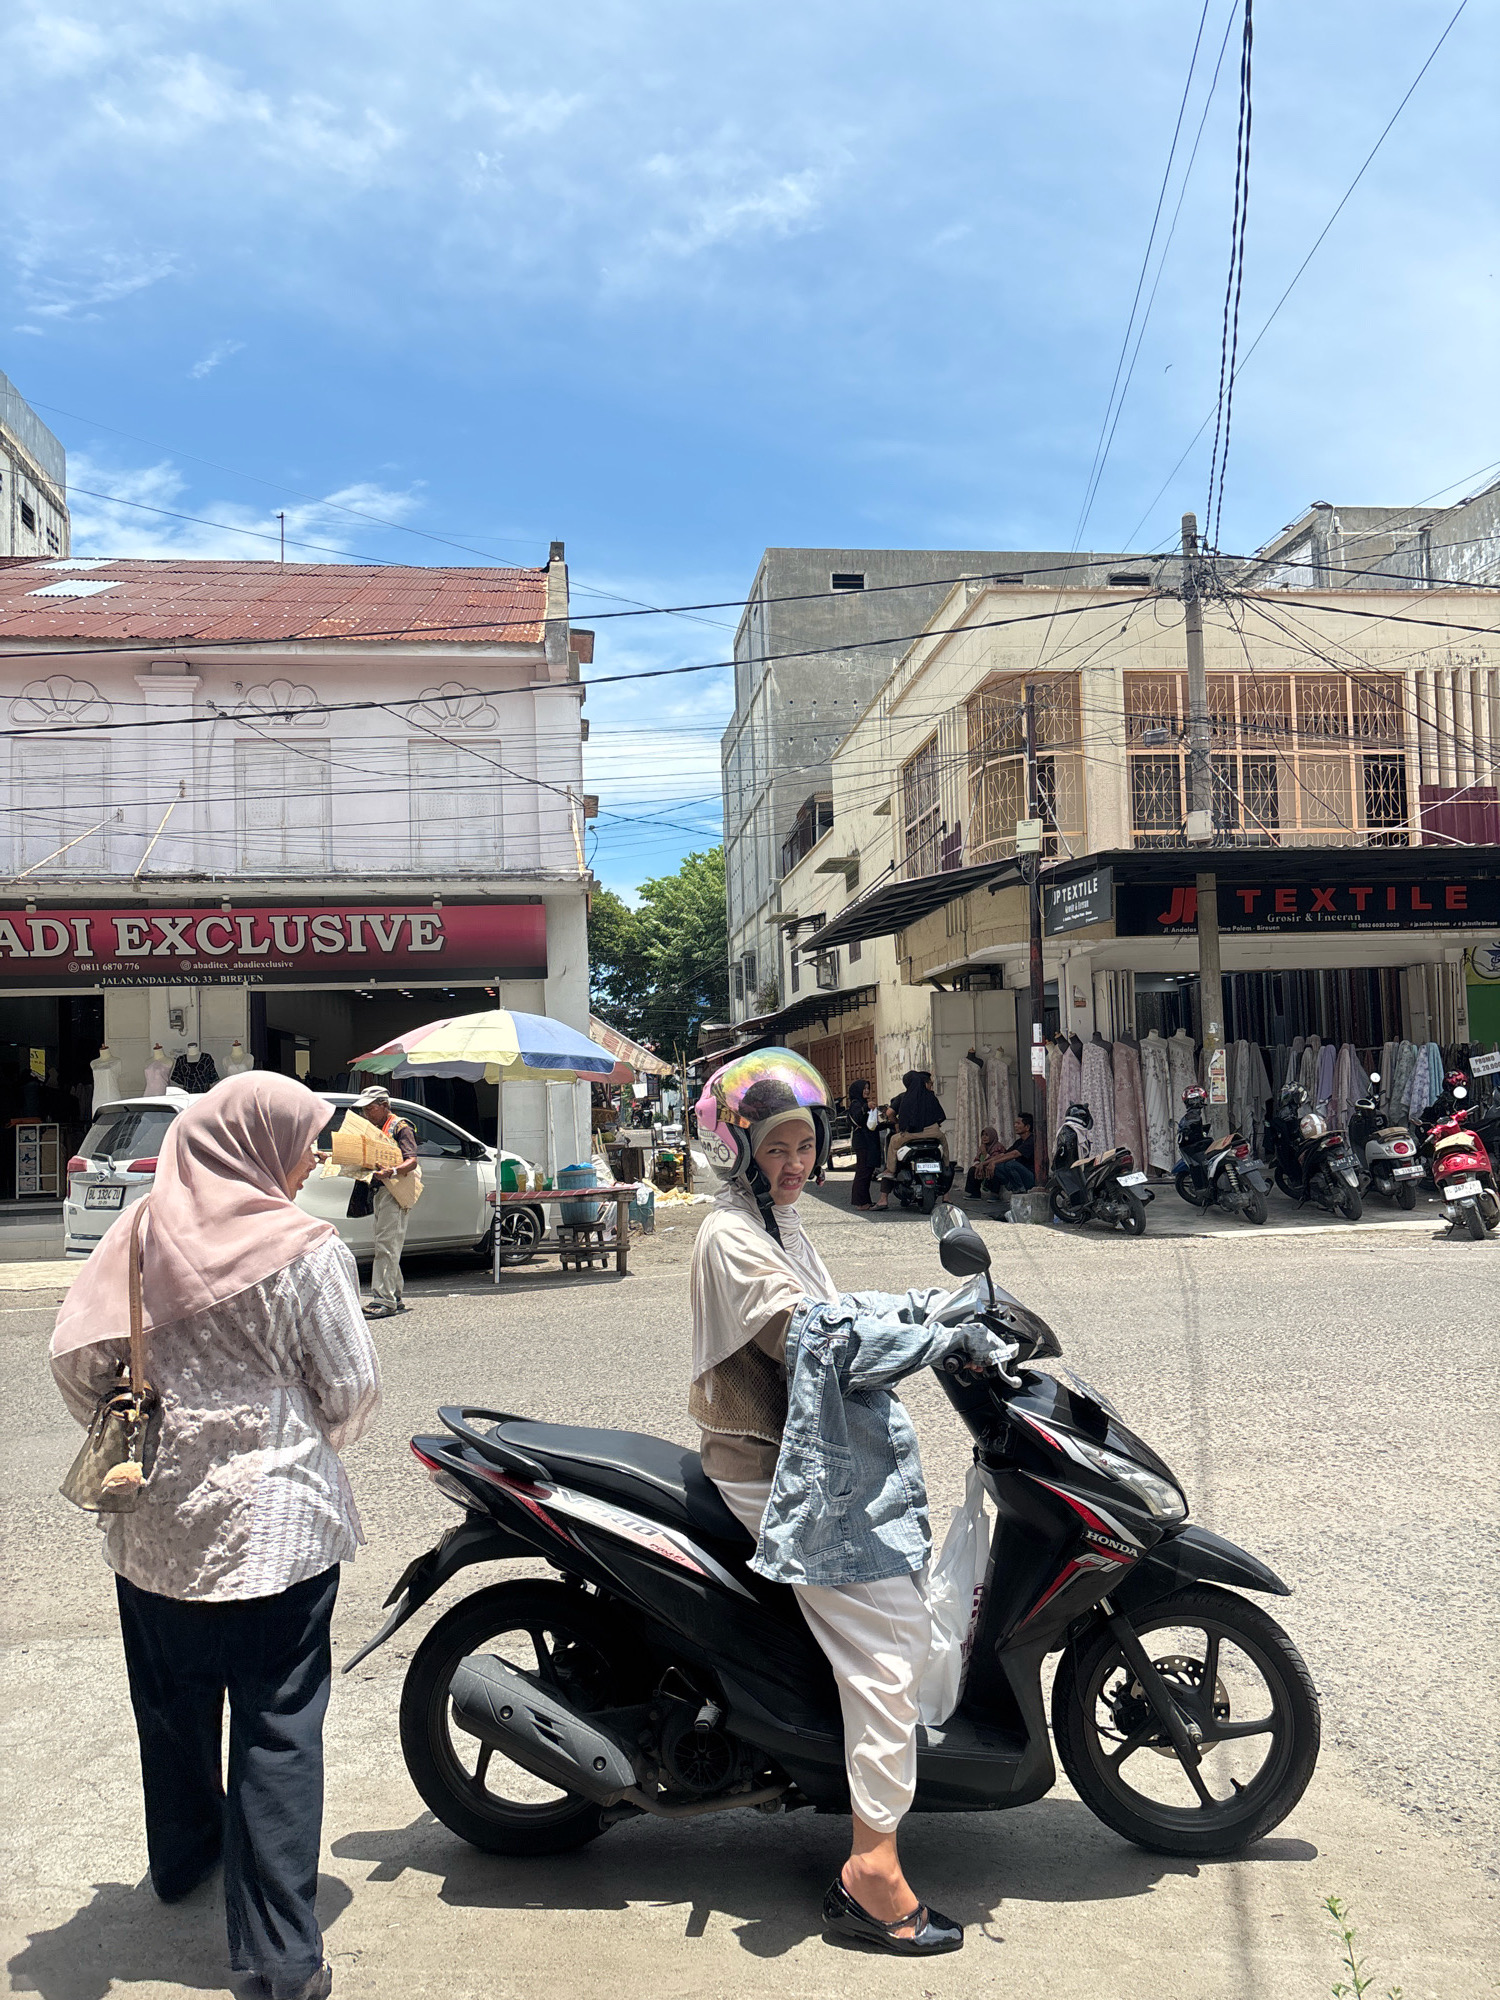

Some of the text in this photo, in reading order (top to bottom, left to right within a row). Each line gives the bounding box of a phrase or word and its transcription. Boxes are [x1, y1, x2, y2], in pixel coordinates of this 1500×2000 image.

[1053, 877, 1098, 905] JP TEXTILE
[1236, 886, 1468, 913] TEXTILE
[1267, 913, 1301, 922] Grosir
[1305, 912, 1313, 922] &
[111, 913, 445, 957] EXCLUSIVE
[80, 962, 140, 971] 0811 6870 776
[192, 960, 294, 971] abaditex_abadiexclusive
[101, 977, 133, 985] JALAN
[135, 976, 181, 985] ANDALAS
[183, 975, 200, 984] NO.
[202, 975, 212, 984] 33
[220, 974, 264, 984] BIREUEN
[1475, 1055, 1495, 1065] PROMO
[1086, 1530, 1139, 1558] HONDA
